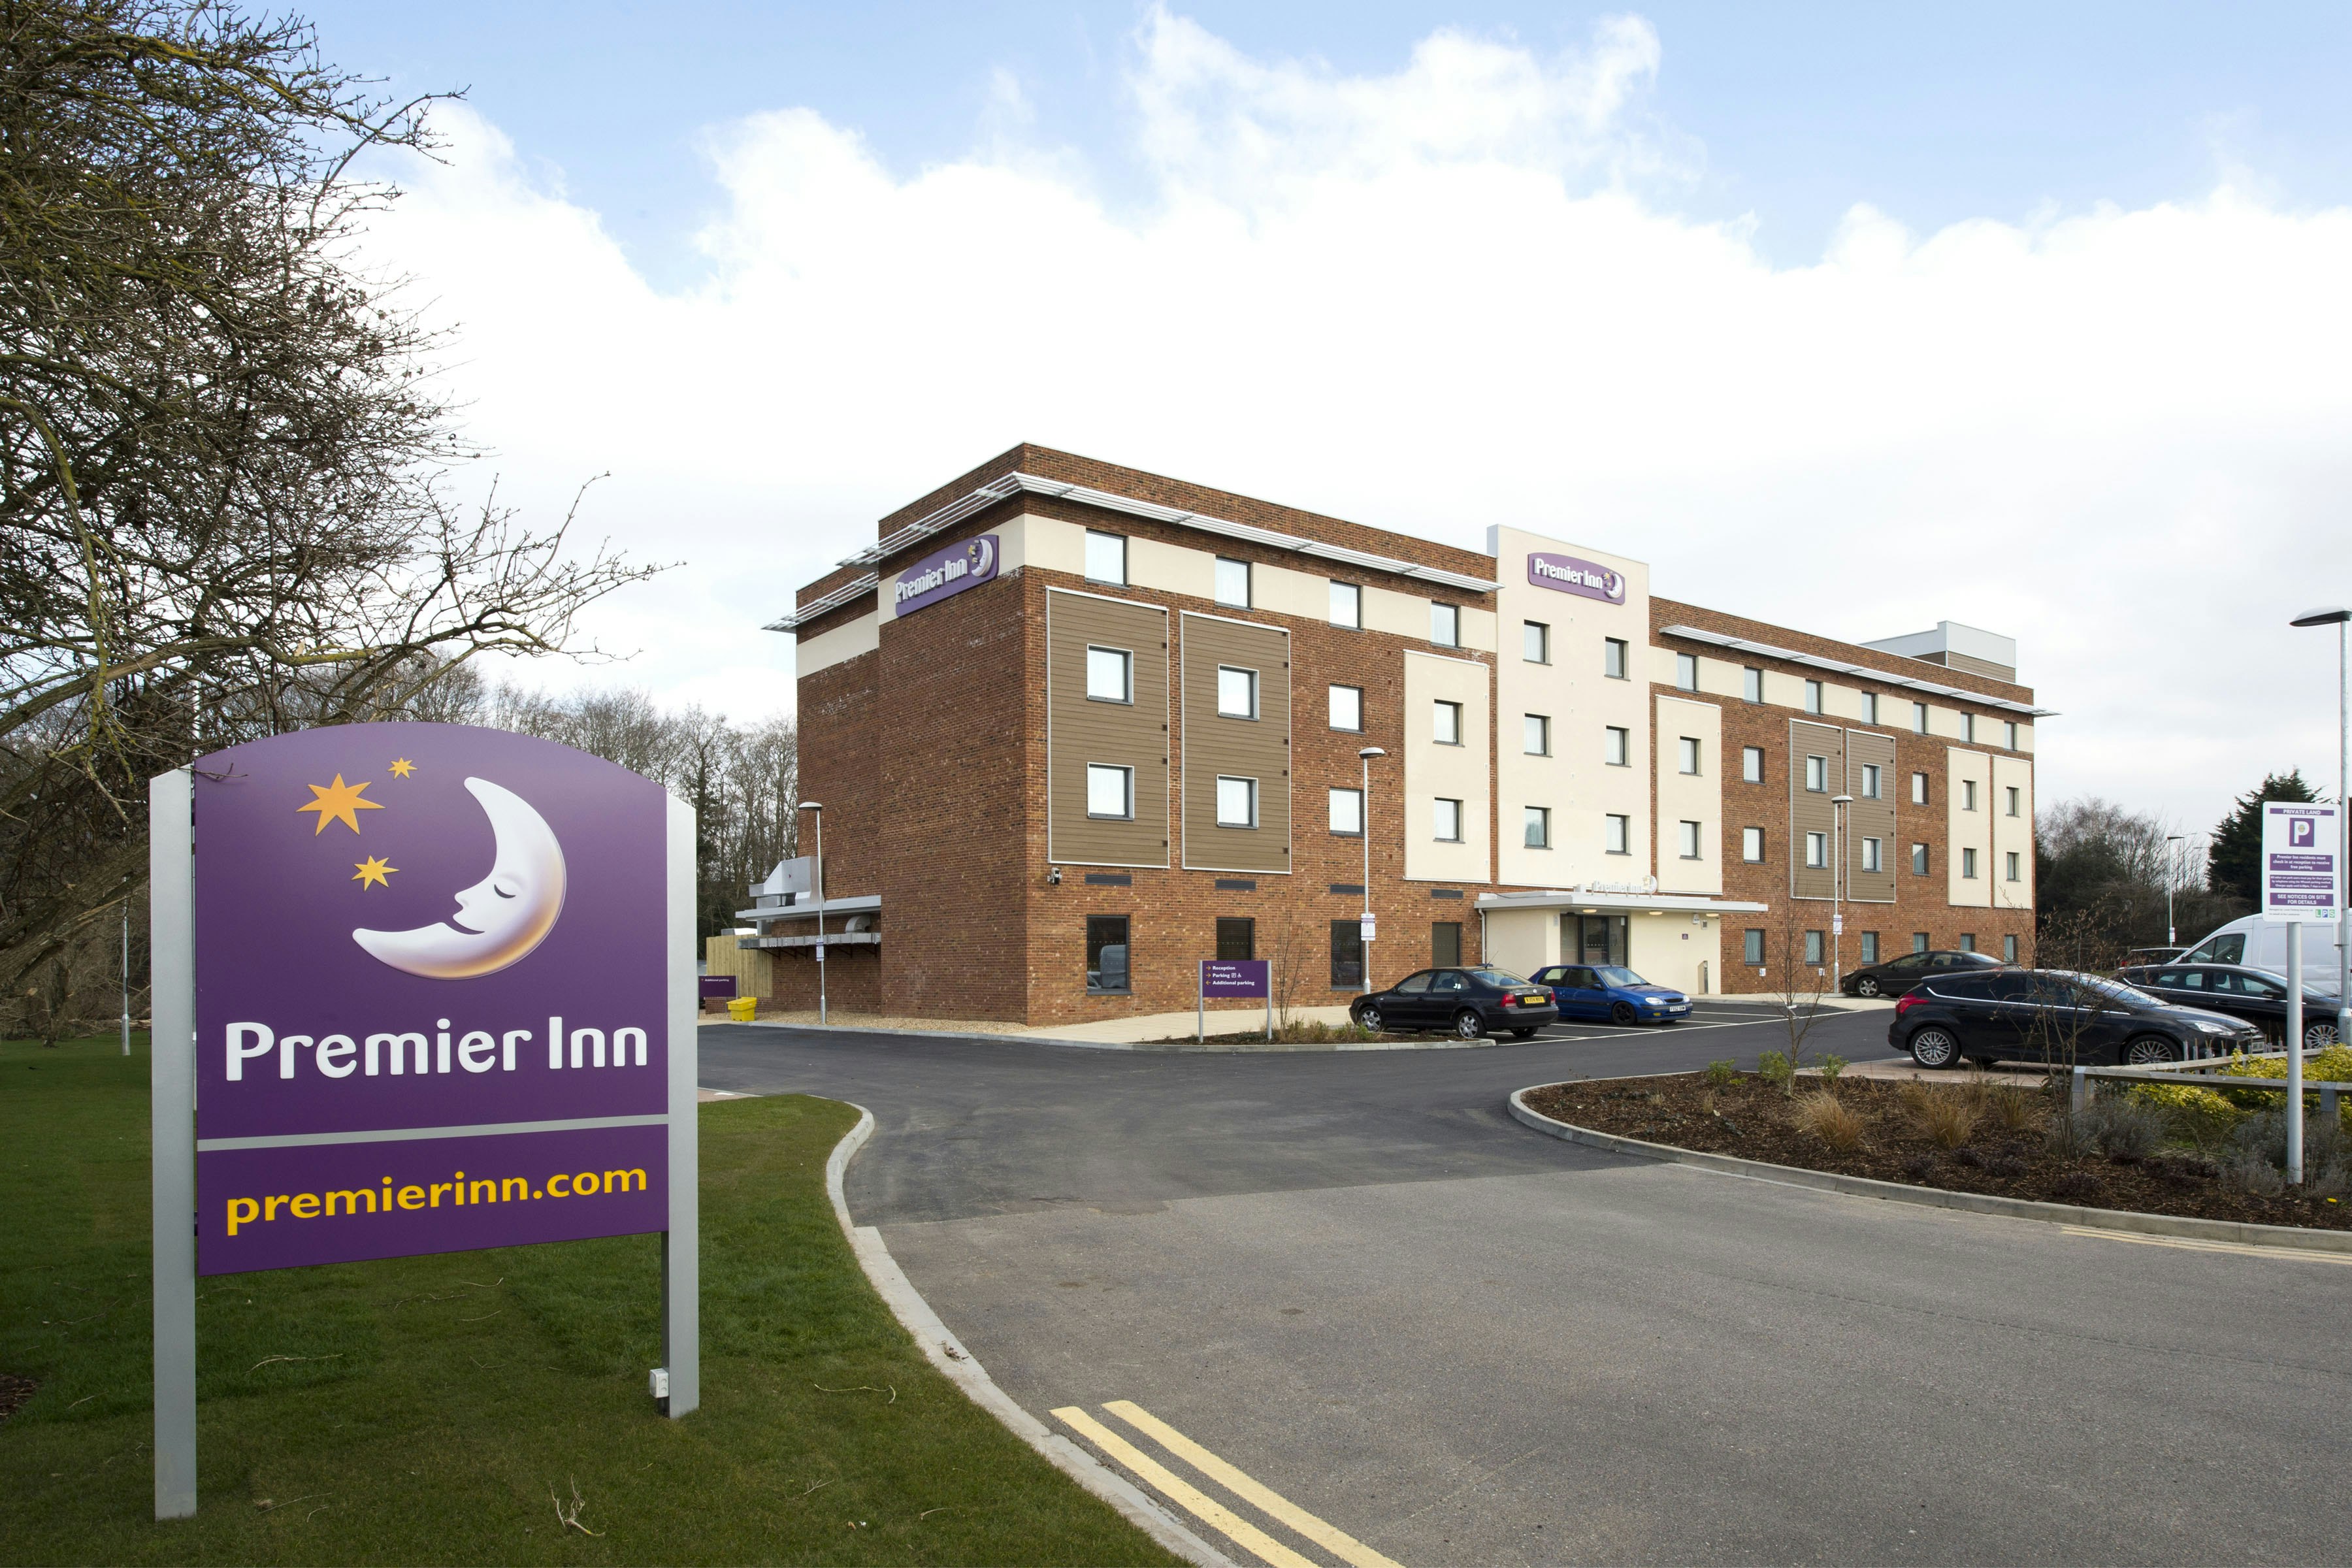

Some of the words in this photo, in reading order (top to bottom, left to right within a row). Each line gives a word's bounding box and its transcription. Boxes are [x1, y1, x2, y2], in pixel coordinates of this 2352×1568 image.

[896, 568, 945, 603] Premier
[945, 559, 968, 581] Inn
[1534, 558, 1583, 584] Premier
[1583, 570, 1603, 589] Inn
[226, 1019, 532, 1081] Premier
[549, 1017, 647, 1069] Inn
[227, 1168, 647, 1236] premierinn.com
